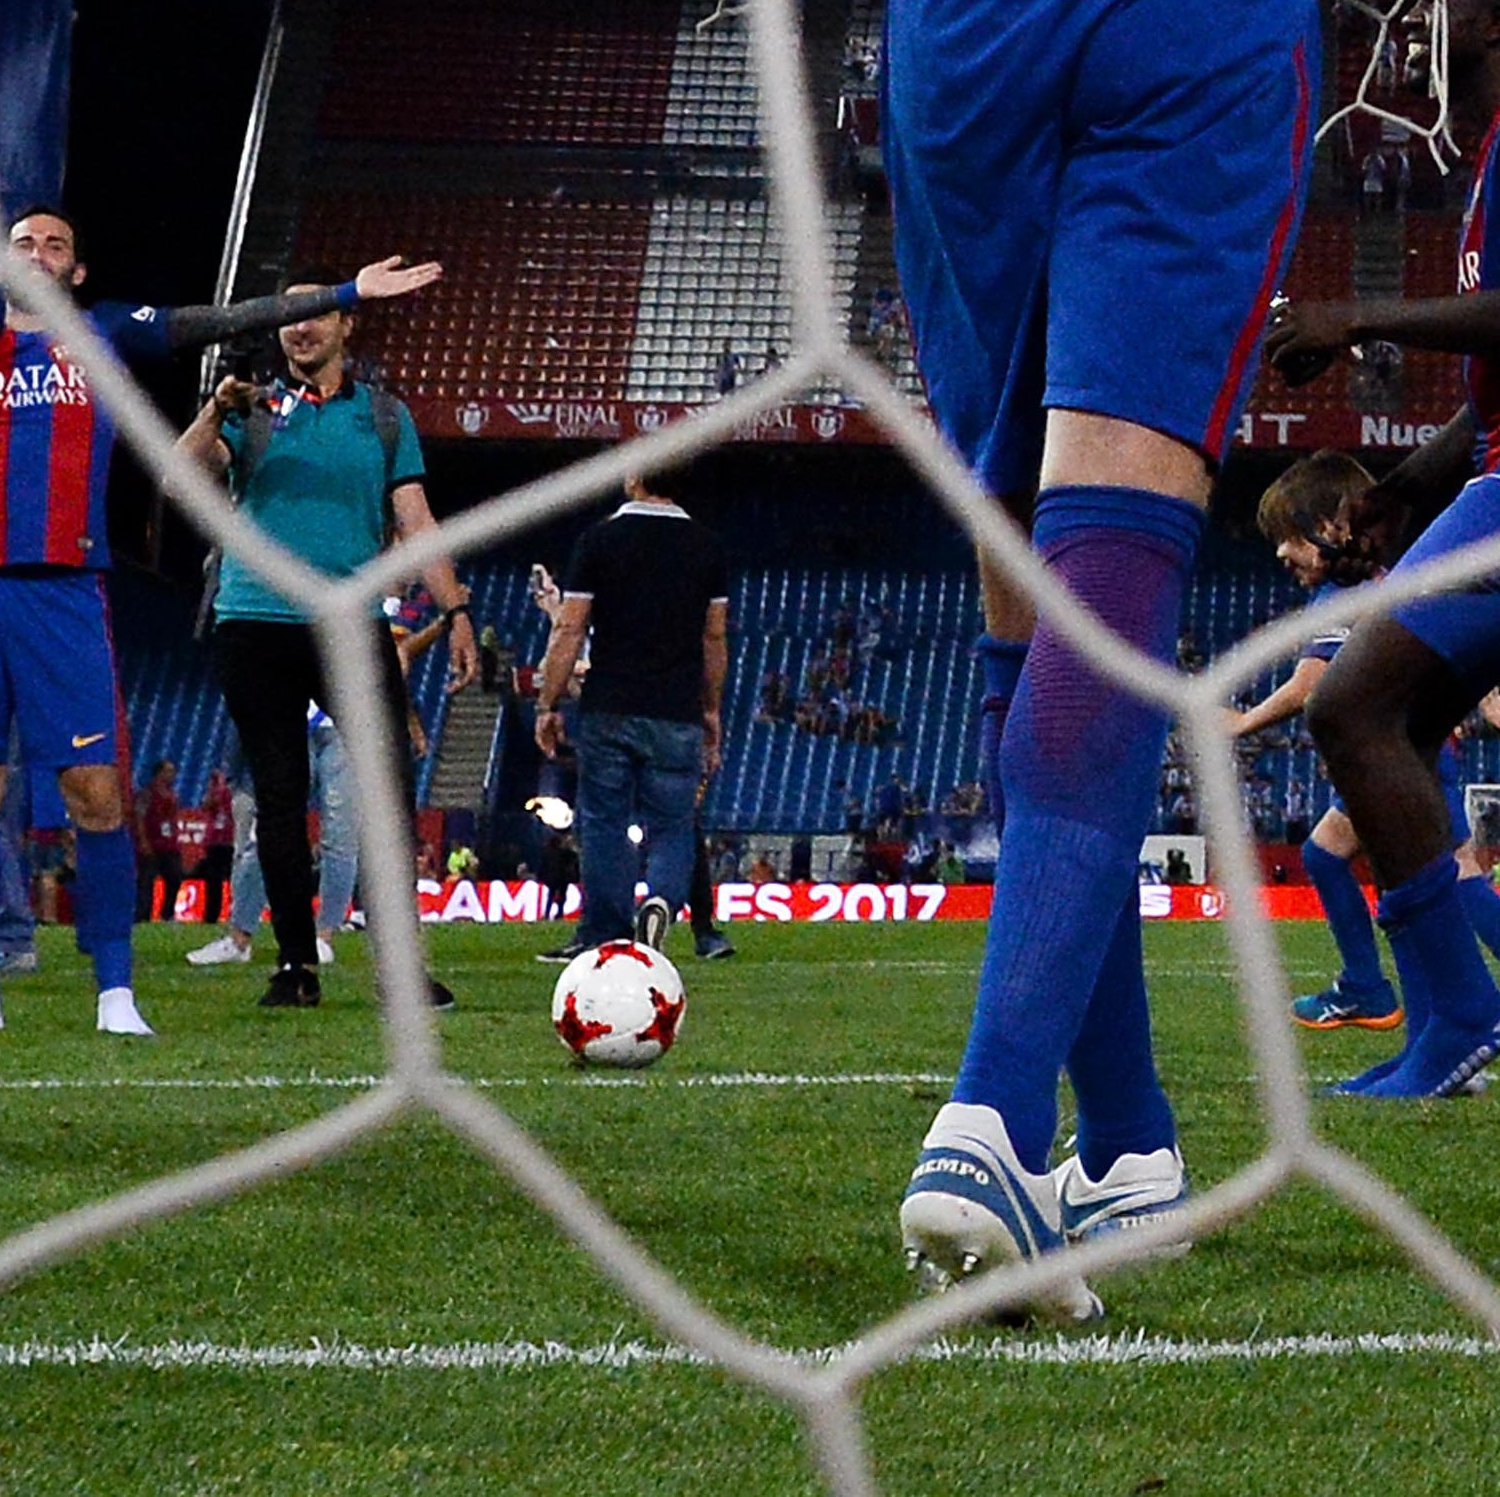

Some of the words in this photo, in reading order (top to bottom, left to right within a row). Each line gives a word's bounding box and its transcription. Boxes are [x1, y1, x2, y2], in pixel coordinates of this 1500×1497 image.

[3, 387, 88, 409] AIRWAYS
[555, 404, 620, 426] FINAL
[1361, 415, 1445, 446] Nue
[808, 883, 947, 922] 2017
